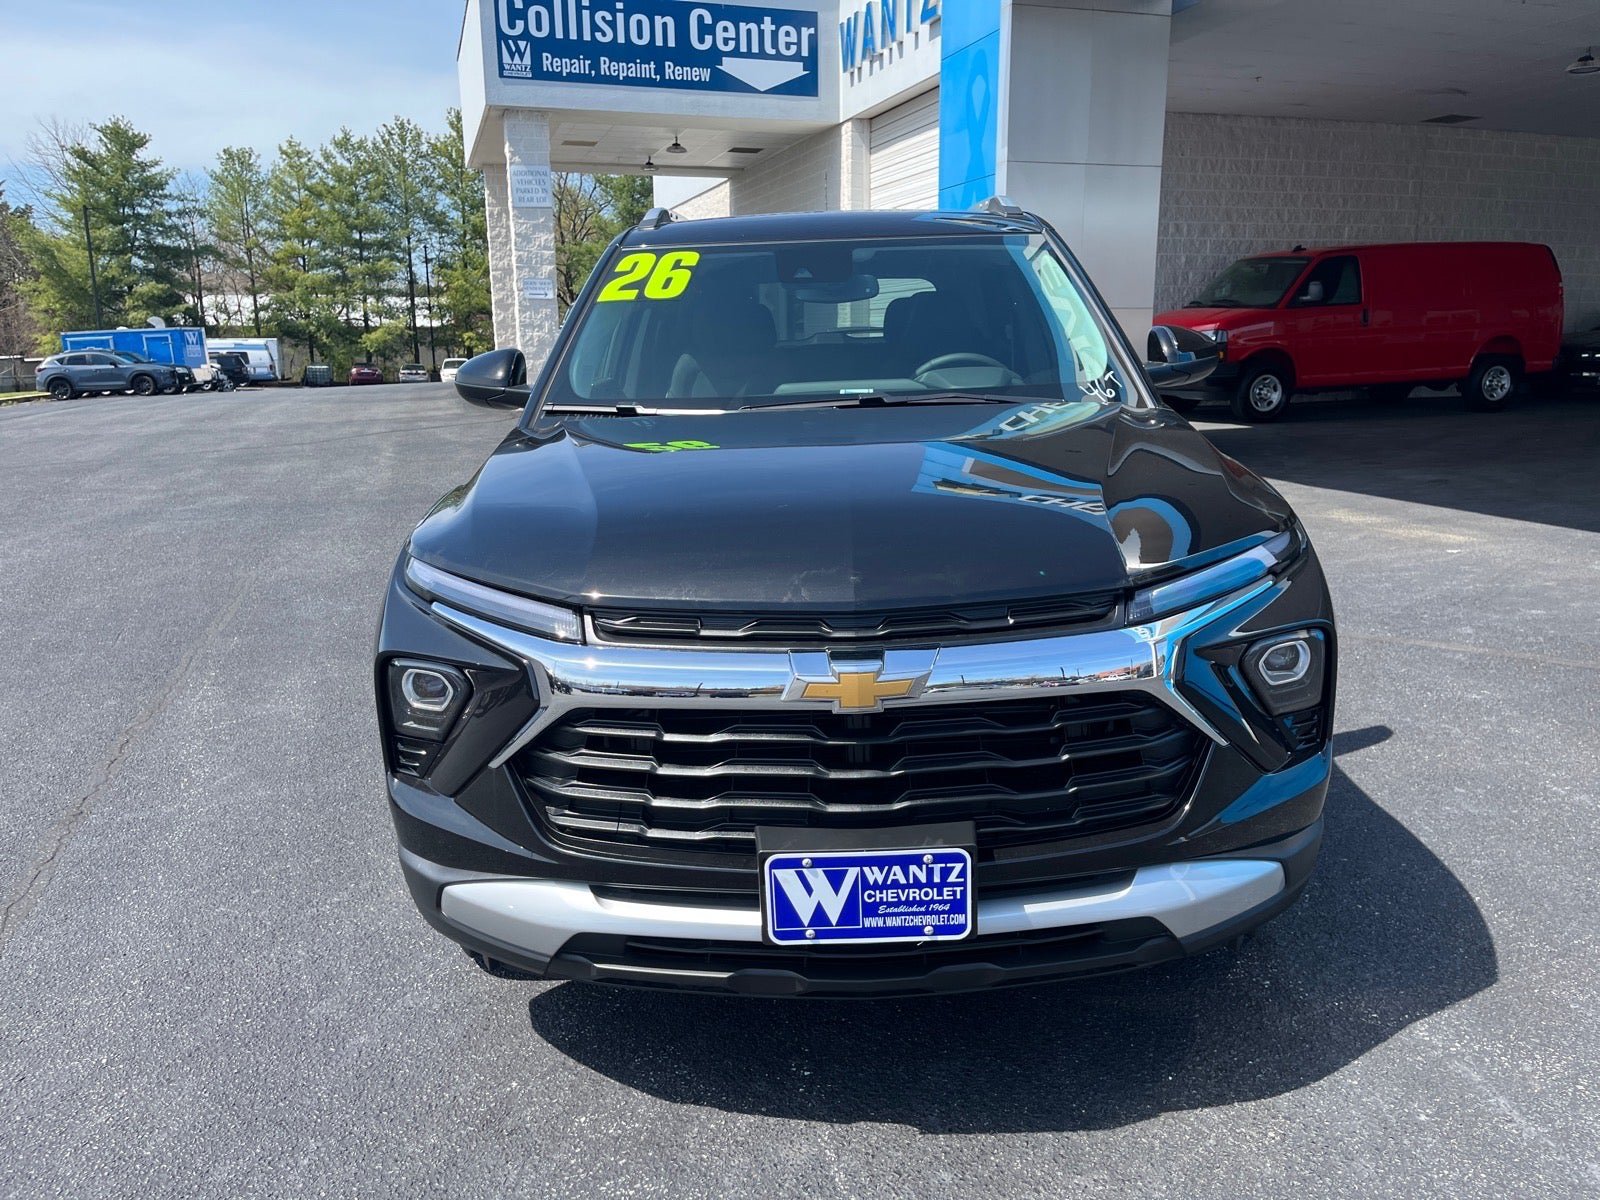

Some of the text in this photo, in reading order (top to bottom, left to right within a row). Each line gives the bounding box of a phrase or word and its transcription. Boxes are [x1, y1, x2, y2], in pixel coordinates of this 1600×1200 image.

[498, 0, 815, 57] Collision Center
[503, 63, 532, 72] WANTZ
[542, 52, 711, 82] Repair, Repaint, Renew
[597, 252, 700, 302] 26
[862, 863, 964, 886] WANTZ
[863, 886, 964, 903] CHEVROLET
[878, 903, 950, 914] Established 1964
[863, 913, 966, 928] WWW.WANTZCHEVROLET.COM
